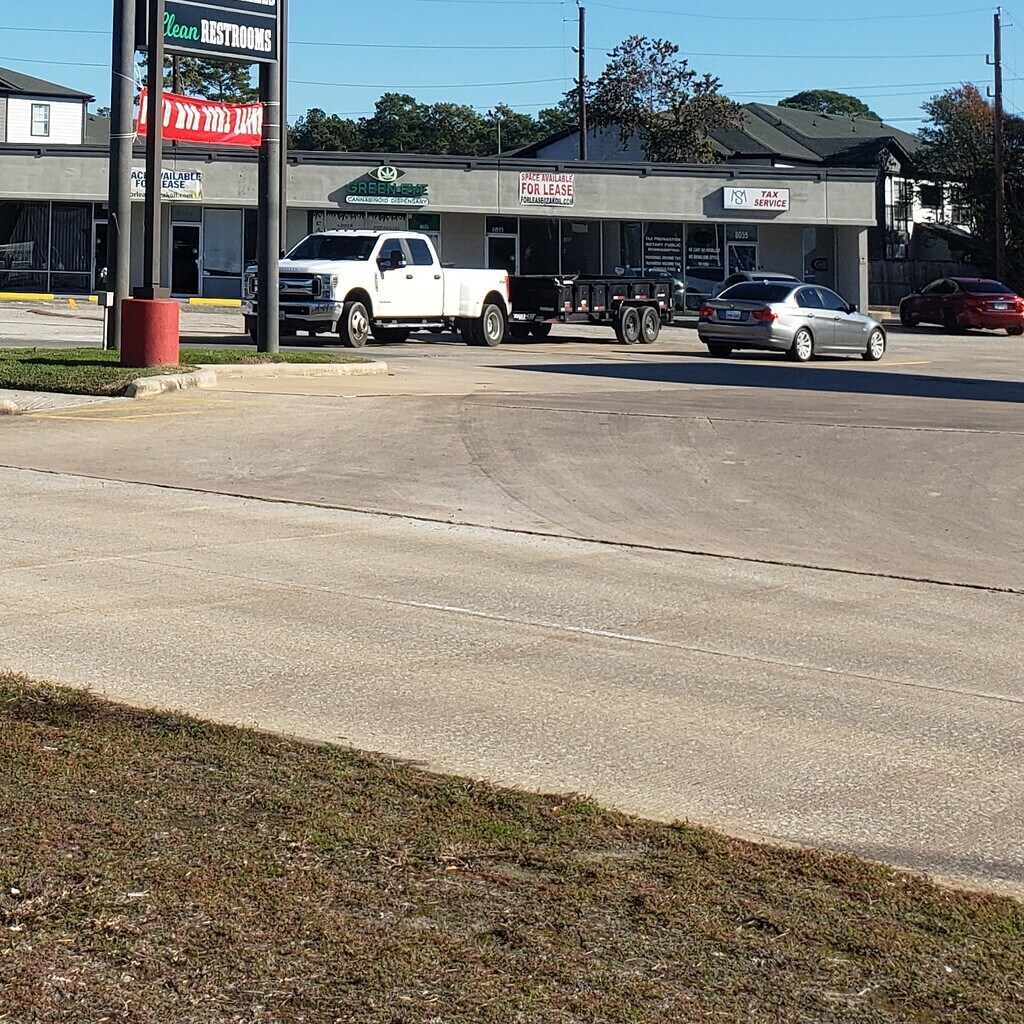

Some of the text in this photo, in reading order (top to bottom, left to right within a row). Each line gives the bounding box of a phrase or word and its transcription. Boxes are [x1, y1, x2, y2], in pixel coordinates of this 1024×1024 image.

[201, 19, 272, 52] RESTROOMS
[161, 172, 202, 181] AILABLE
[521, 173, 573, 183] SPACE AVAILABLE
[135, 179, 185, 188] FO EASE
[347, 182, 429, 195] GREEN EYE
[521, 182, 573, 196] FOR LEASE
[754, 199, 787, 207] SERVICE
[734, 231, 749, 239] 8035
